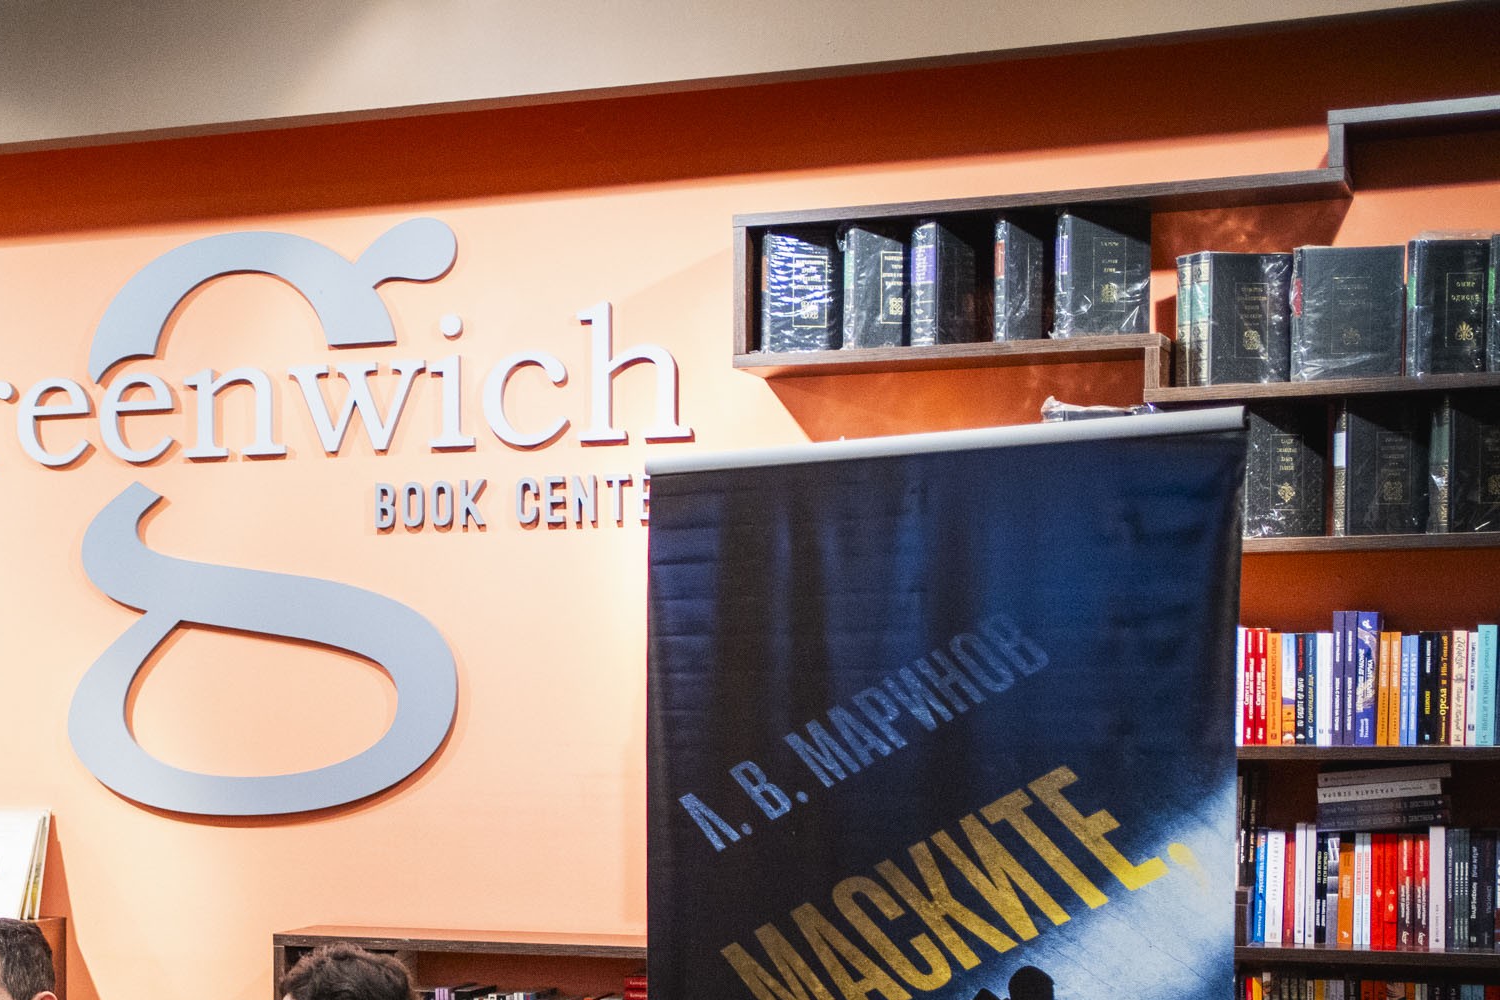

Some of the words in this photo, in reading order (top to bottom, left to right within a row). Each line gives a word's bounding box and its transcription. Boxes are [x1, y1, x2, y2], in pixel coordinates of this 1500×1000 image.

[374, 479, 488, 531] BOOK
[515, 473, 648, 527] CENTE
[729, 760, 809, 820] В.
[782, 611, 1052, 788] МАРИНОВ
[1439, 688, 1449, 716] орела
